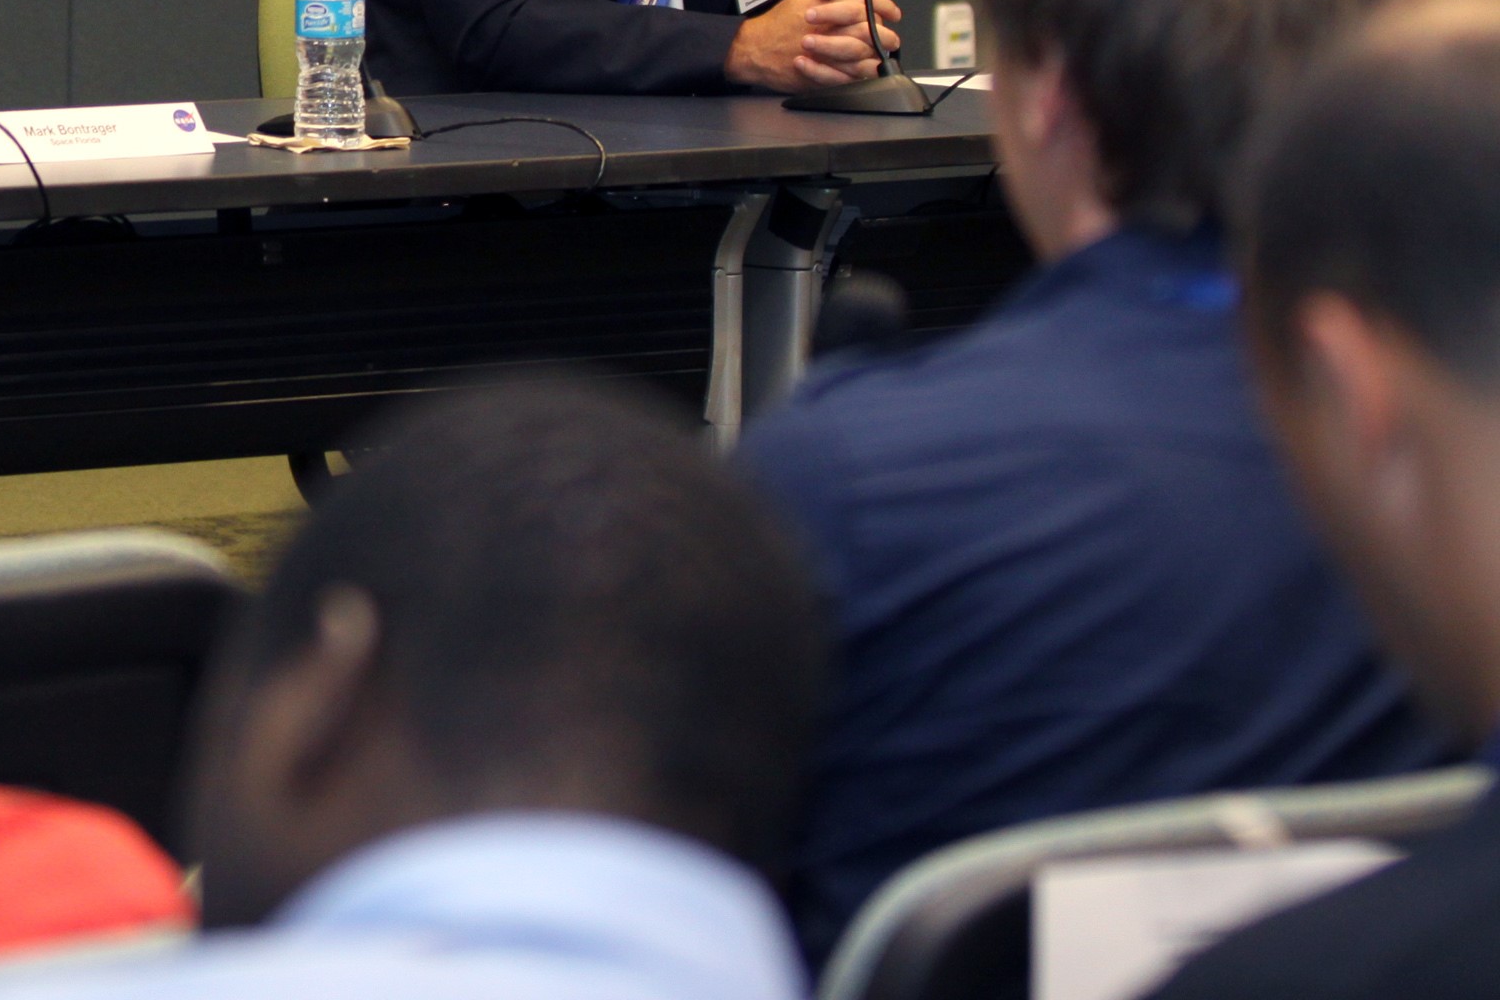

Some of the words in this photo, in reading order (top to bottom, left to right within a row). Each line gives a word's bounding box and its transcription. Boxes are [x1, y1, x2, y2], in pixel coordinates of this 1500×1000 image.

[23, 125, 55, 137] Mark
[56, 123, 117, 137] Bontrager
[50, 138, 74, 146] Space
[75, 136, 100, 145] Florida
